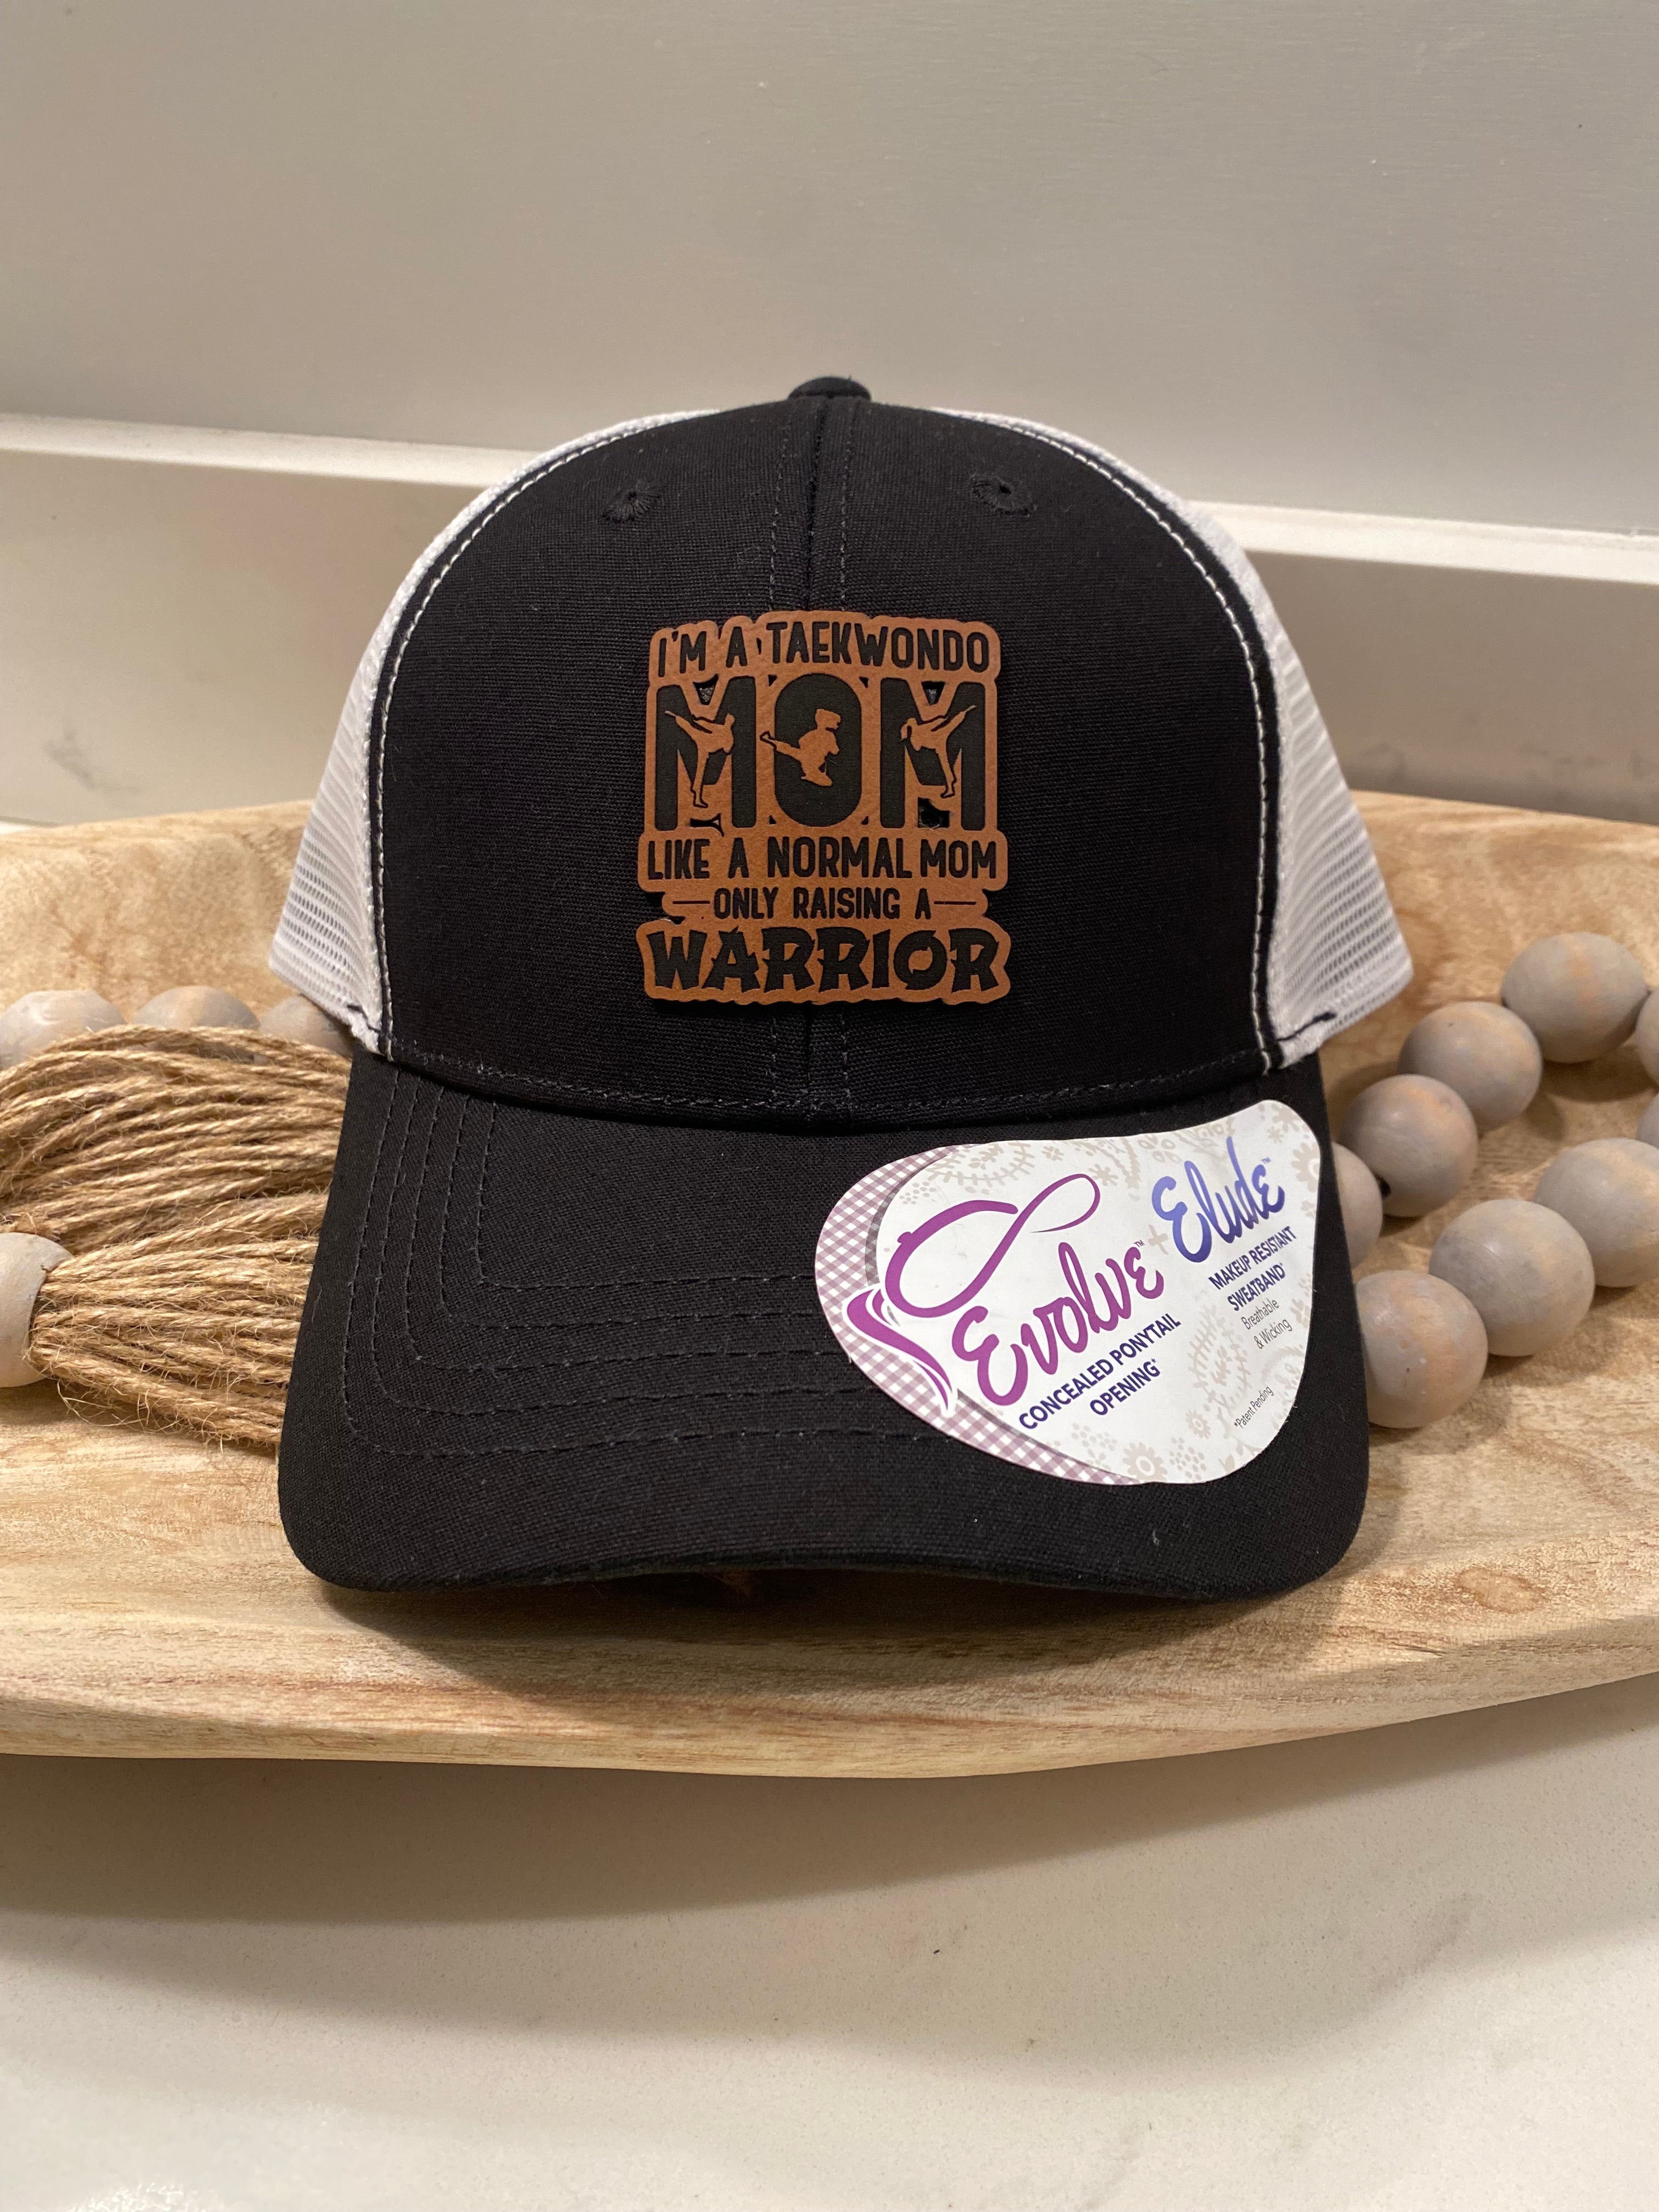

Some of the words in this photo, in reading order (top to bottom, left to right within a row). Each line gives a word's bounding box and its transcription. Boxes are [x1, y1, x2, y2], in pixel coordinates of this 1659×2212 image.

[658, 630, 707, 678] I'M
[726, 626, 748, 667] A
[766, 621, 990, 673] TAEKWONDO
[654, 673, 986, 832] MOM
[647, 838, 710, 879] LIKE
[728, 837, 750, 879] A
[768, 836, 913, 879] NORMAL
[920, 839, 997, 879] MOM
[714, 887, 778, 919] ONLY
[793, 887, 900, 920] RAISING
[915, 888, 932, 920] A
[647, 926, 1000, 994] WARRIOR
[1208, 1255, 1251, 1290] MAKEUP
[1249, 1226, 1297, 1265] RESISTANT
[1240, 1297, 1279, 1330] Breathable
[1254, 1335, 1264, 1350] &
[1262, 1318, 1293, 1345] Wicking
[1019, 1358, 1114, 1429] CONCEALED
[1109, 1313, 1182, 1366] PONYTAIL
[1250, 1386, 1274, 1412] Pending
